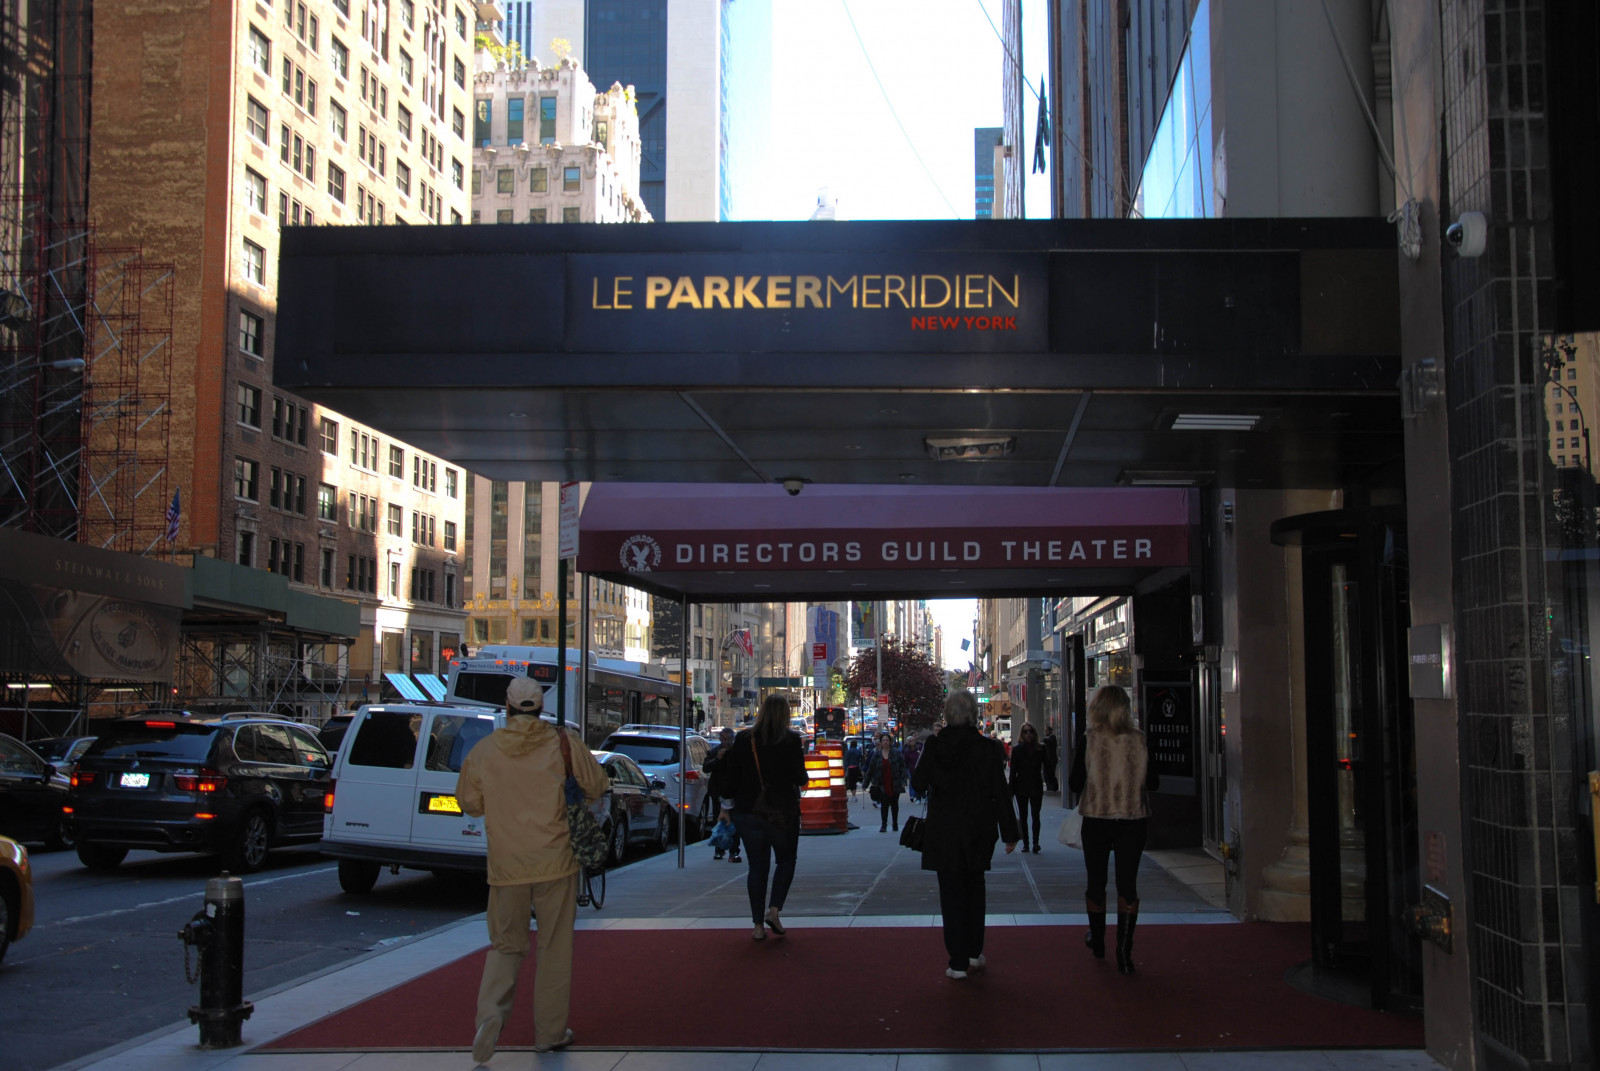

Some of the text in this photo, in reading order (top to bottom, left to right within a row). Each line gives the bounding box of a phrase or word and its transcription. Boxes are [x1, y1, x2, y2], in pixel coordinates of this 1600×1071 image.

[592, 277, 633, 309] LE
[911, 316, 1017, 331] NEW YORK
[676, 539, 1153, 564] DIRECTORS GUILD THEATER
[55, 559, 123, 584] STEINWAY
[137, 575, 164, 590] SONS
[503, 664, 526, 672] 3895
[1149, 724, 1189, 734] DIRECTORS
[1159, 739, 1181, 748] GUILD
[1154, 753, 1185, 763] THEATER
